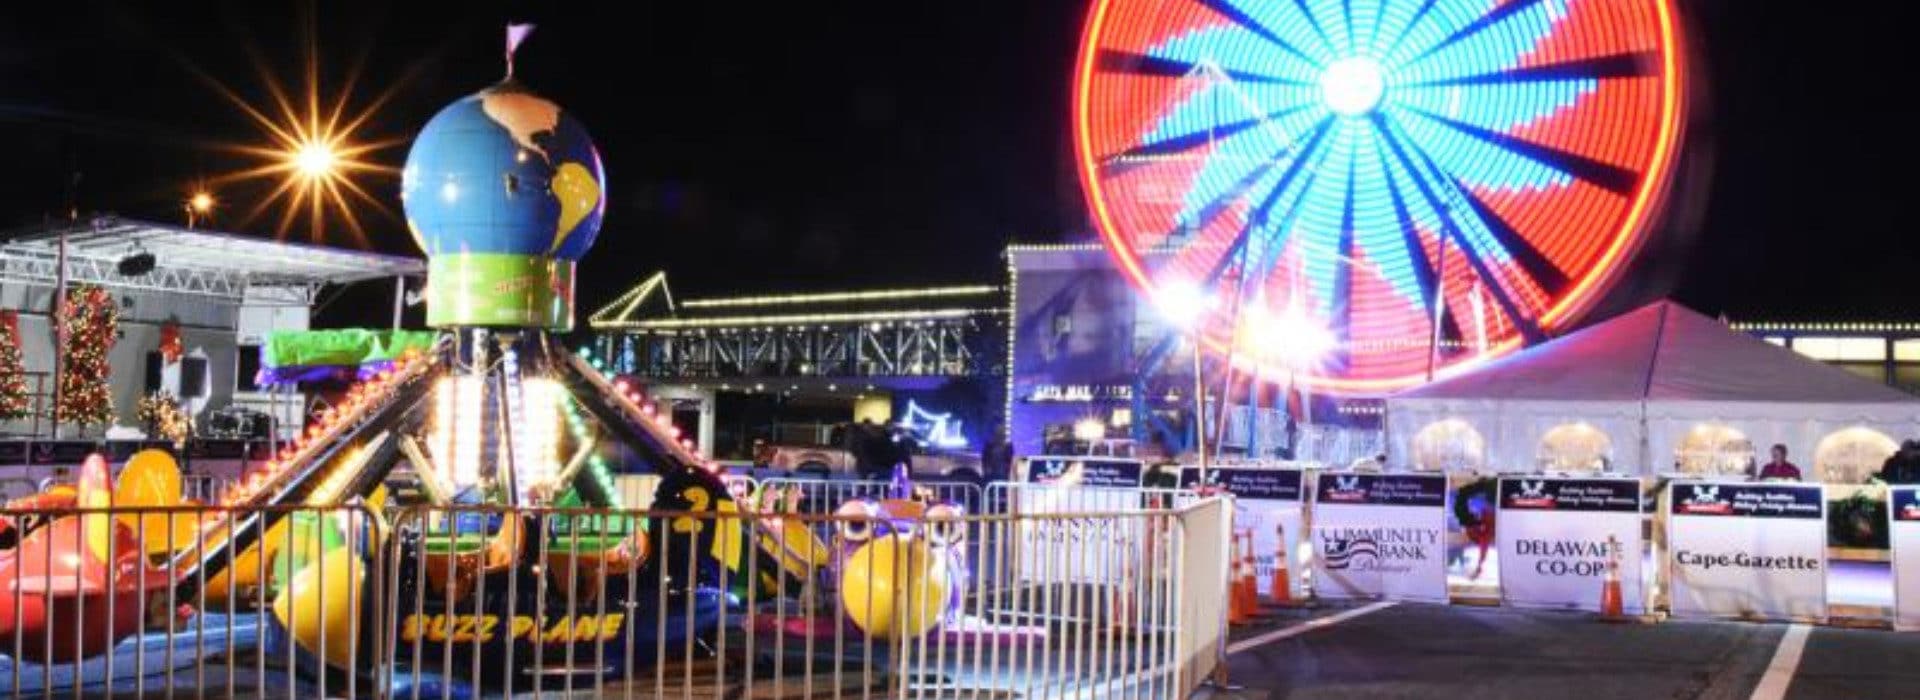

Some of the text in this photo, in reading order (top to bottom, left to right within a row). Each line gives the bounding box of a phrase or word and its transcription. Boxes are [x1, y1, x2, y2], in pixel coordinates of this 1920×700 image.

[1379, 544, 1426, 560] BANK
[402, 613, 624, 643] BUZZ PLANE
